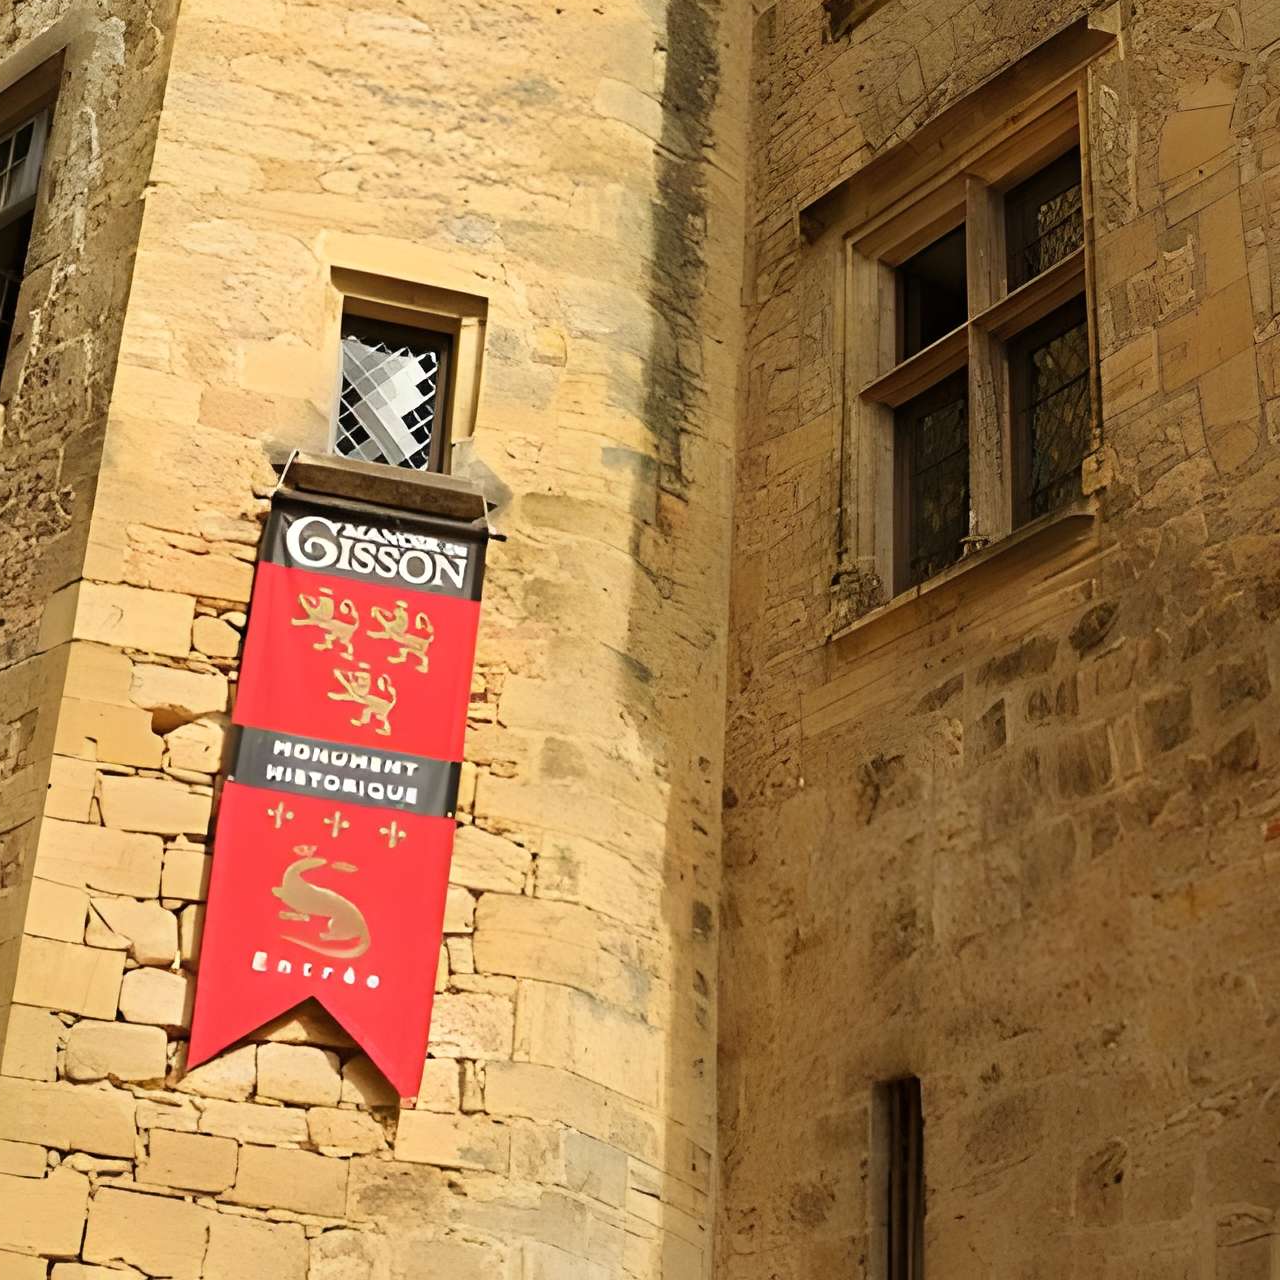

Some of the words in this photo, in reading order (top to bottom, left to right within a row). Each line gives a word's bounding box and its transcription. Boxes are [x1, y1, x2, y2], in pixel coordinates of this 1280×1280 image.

[286, 516, 467, 588] GISSON
[273, 740, 419, 776] MONUMENT
[266, 764, 418, 804] HISTORIQUE
